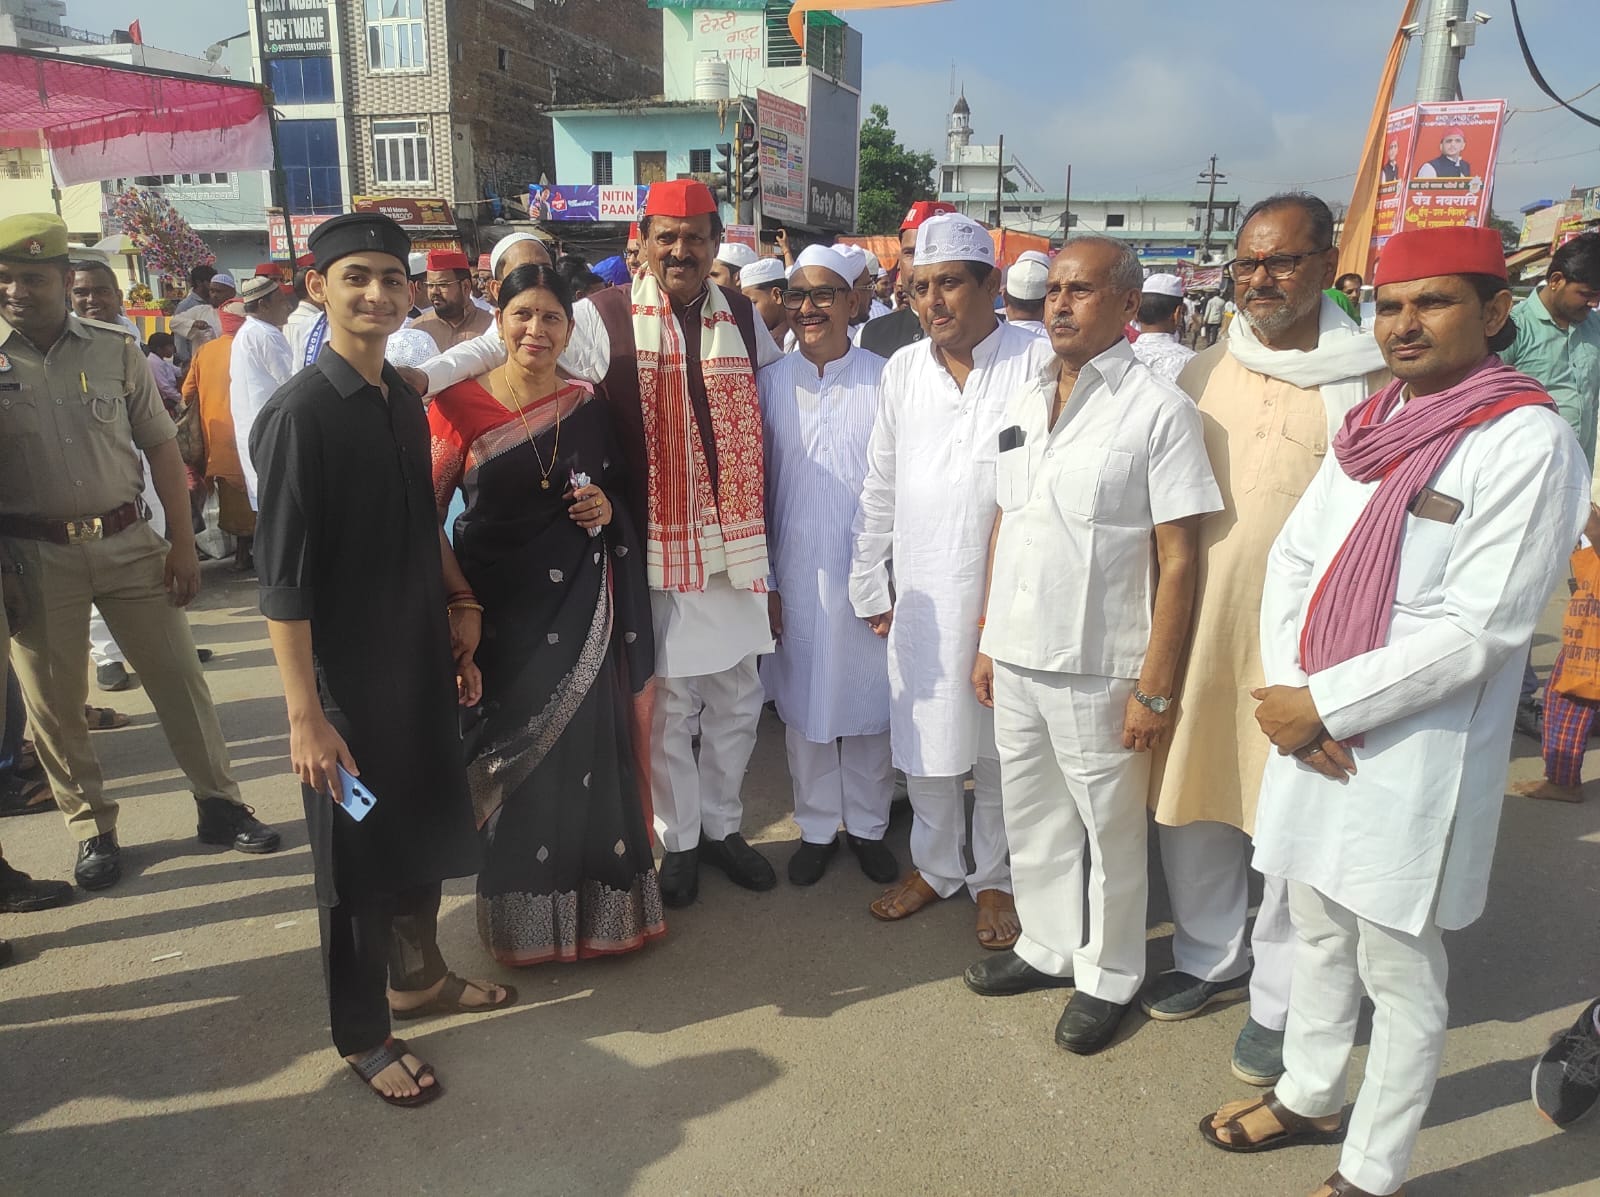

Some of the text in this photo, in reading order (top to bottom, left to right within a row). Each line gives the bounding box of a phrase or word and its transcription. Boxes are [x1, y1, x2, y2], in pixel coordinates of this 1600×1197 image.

[267, 16, 324, 40] SOFTWARE
[602, 191, 634, 201] NITIN
[811, 186, 834, 220] Tasty
[835, 191, 852, 219] Bite
[601, 204, 635, 215] PAAN
